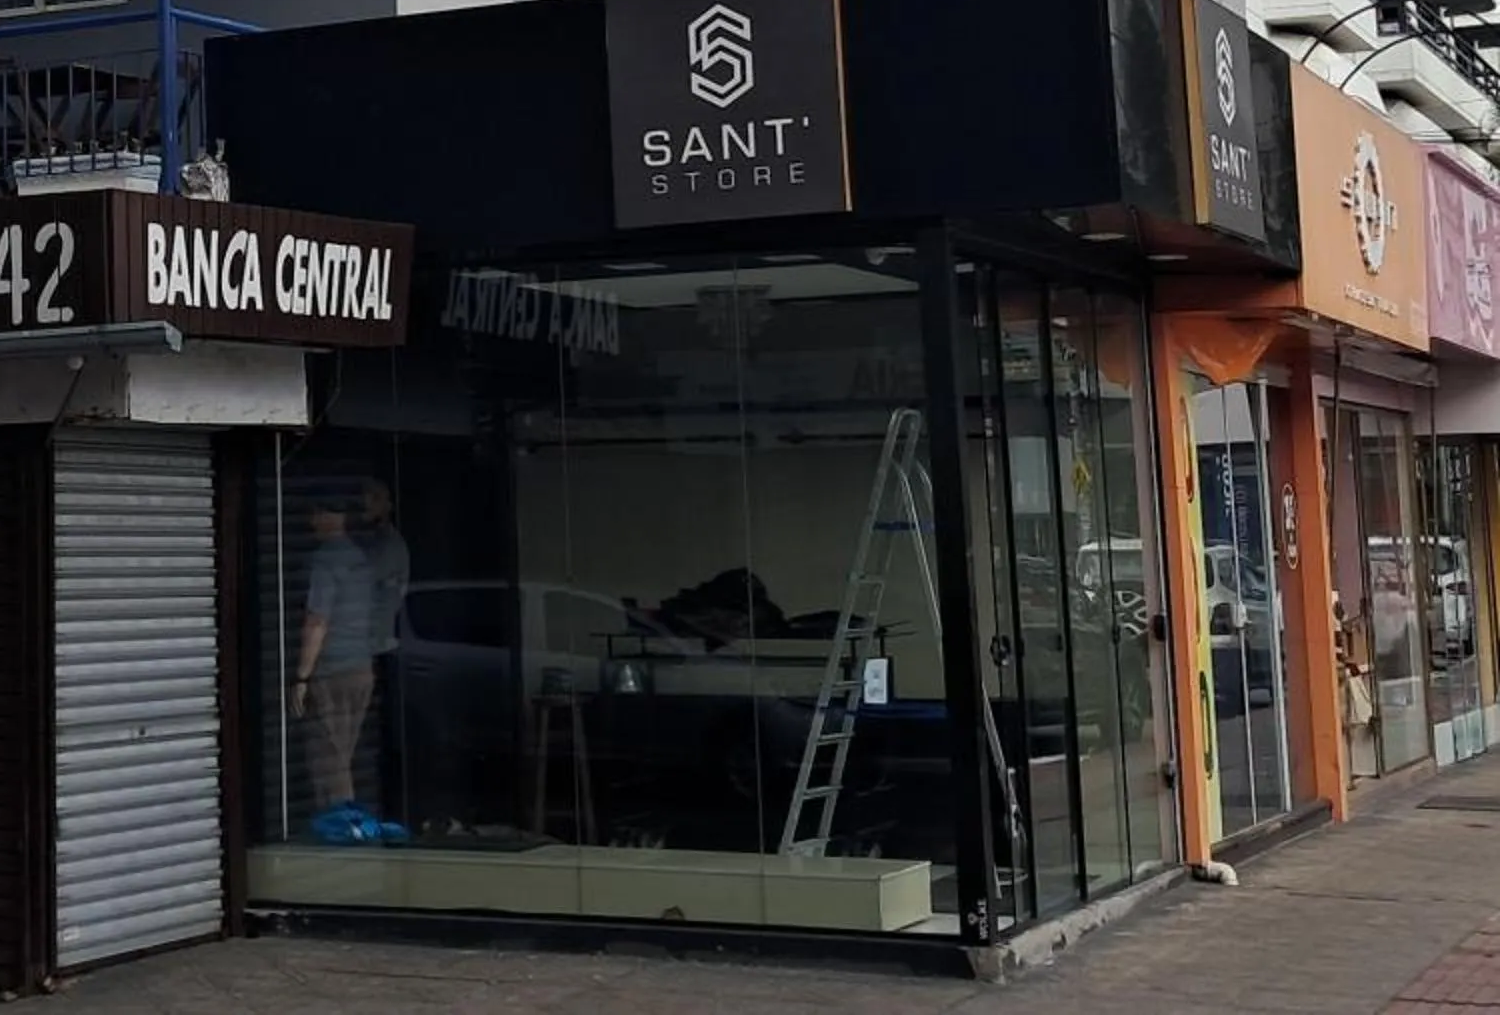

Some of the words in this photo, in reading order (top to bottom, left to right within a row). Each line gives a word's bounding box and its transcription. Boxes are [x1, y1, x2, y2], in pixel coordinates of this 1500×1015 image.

[651, 162, 806, 195] STORE
[1215, 177, 1254, 212] STORE
[146, 221, 265, 312] BANCA
[274, 234, 394, 320] CENTRAL
